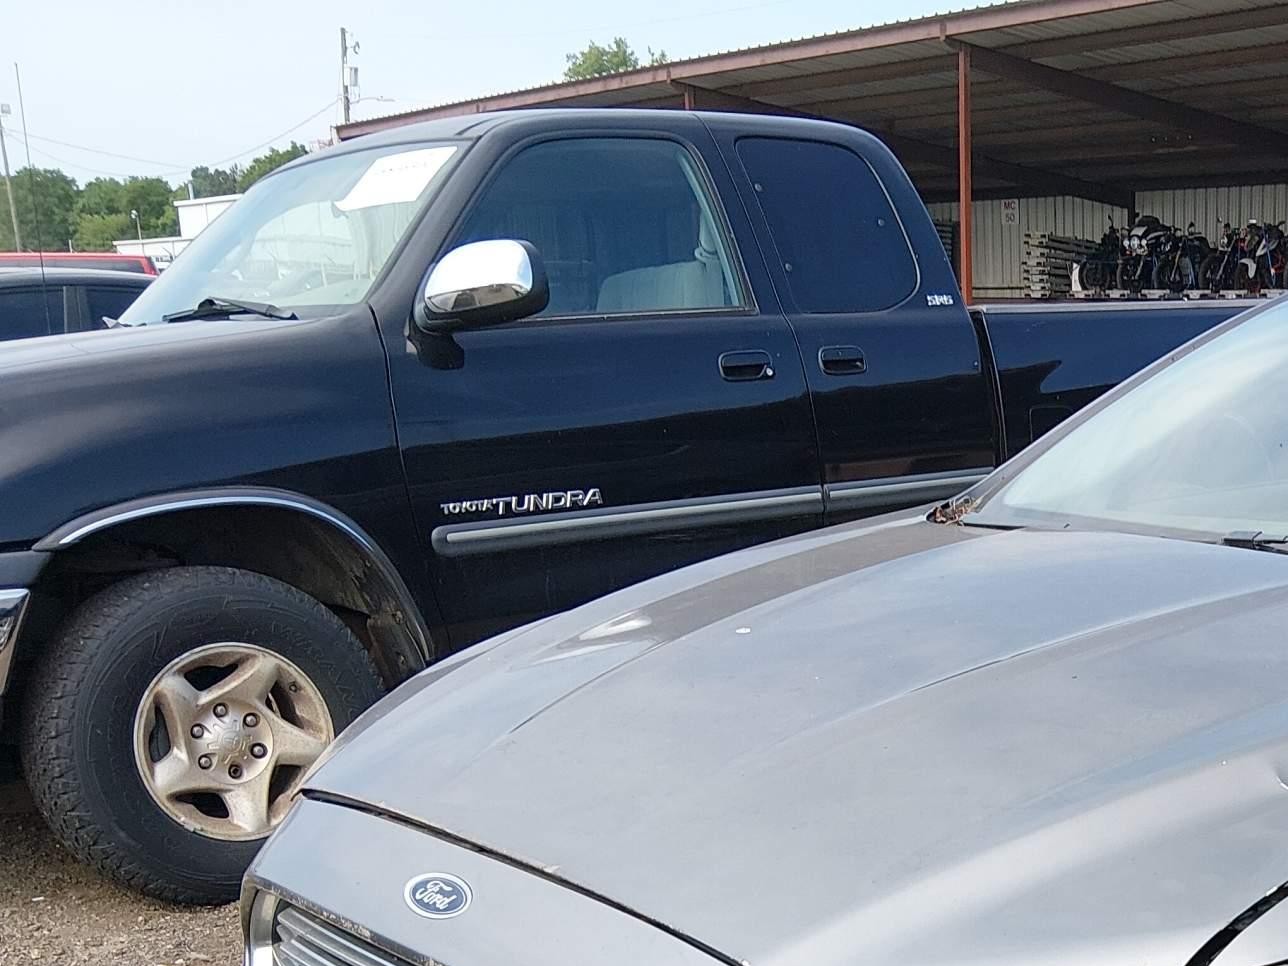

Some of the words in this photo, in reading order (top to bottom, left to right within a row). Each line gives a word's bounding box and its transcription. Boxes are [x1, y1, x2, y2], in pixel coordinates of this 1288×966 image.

[440, 499, 494, 515] TOYOTA
[493, 488, 604, 516] TUNDRA
[415, 880, 458, 910] Ford
